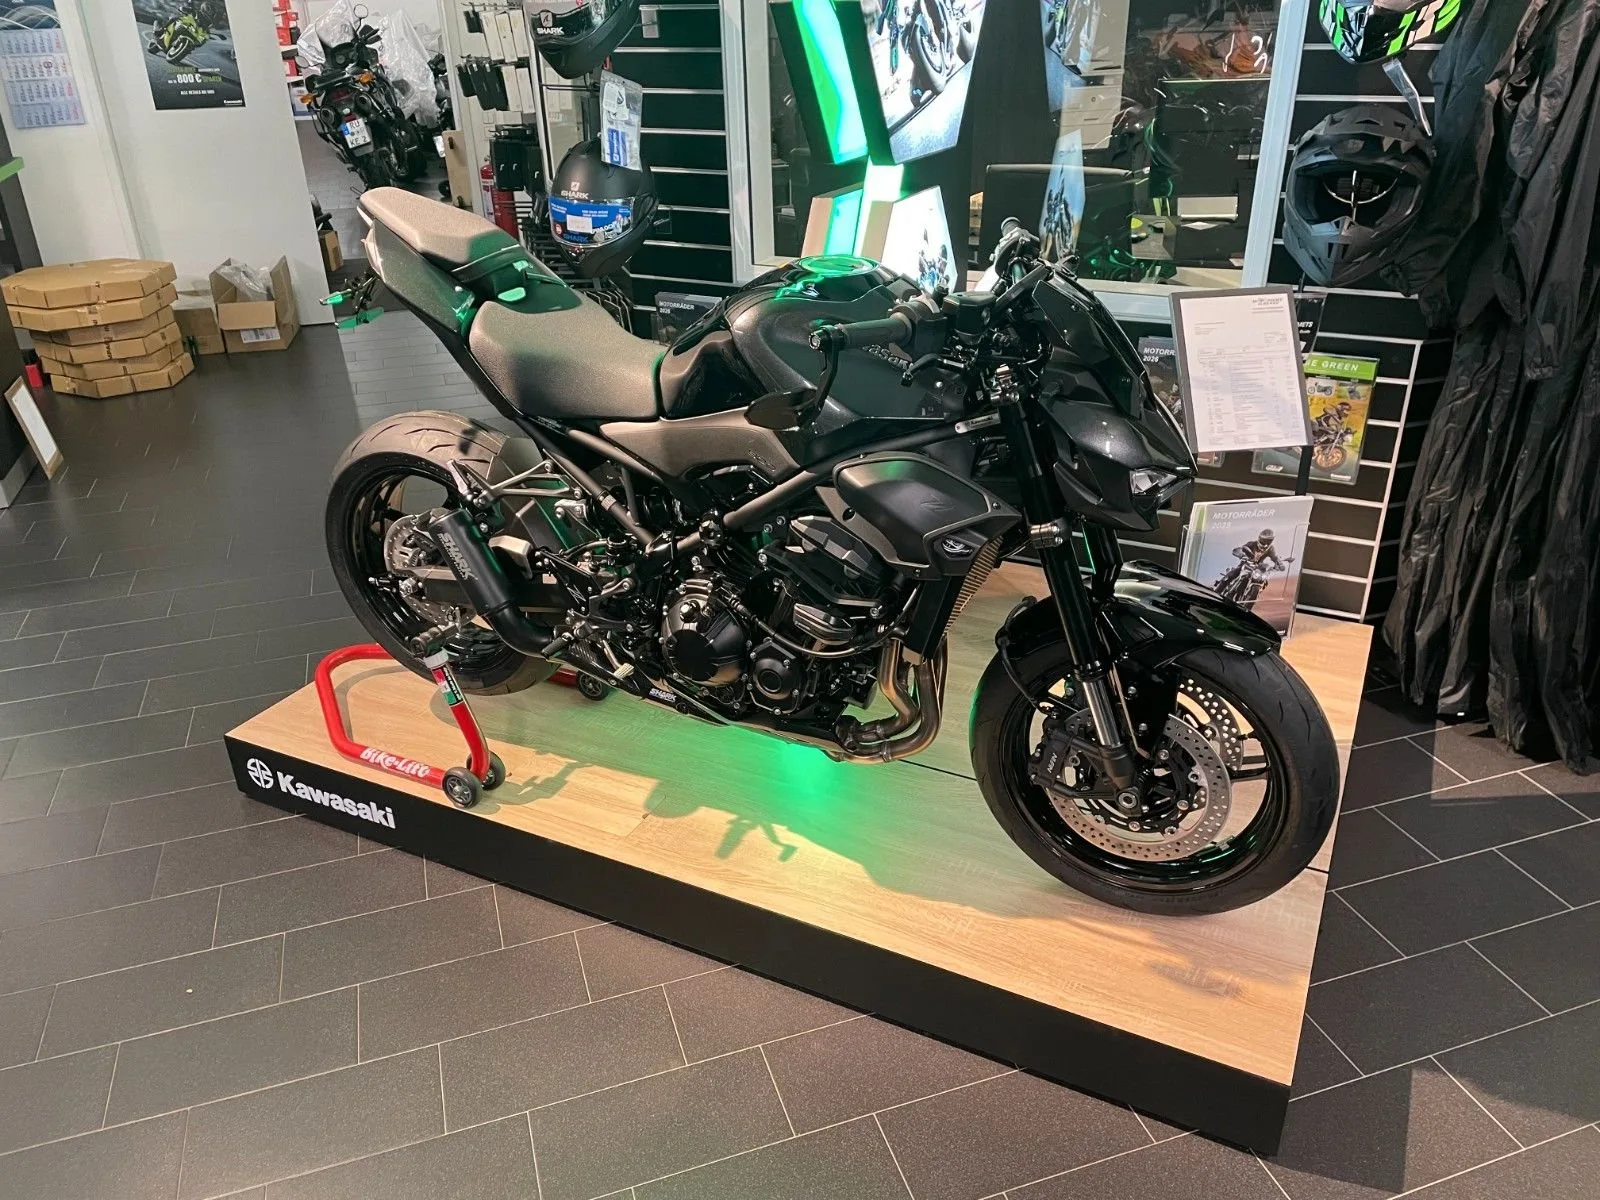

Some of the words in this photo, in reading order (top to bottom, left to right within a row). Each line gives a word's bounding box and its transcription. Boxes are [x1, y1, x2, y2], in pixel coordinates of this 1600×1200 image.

[537, 26, 565, 36] SHARK
[561, 190, 589, 199] SHARK
[659, 300, 695, 310] MOTORRÄDER
[1143, 347, 1176, 356] MOTORR
[1321, 360, 1360, 371] GREEN
[1212, 508, 1276, 520] MOTORRÄDER
[443, 532, 479, 580] SHARK
[649, 688, 677, 702] SHARK
[360, 747, 430, 778] Bike-Lift
[277, 771, 396, 830] Kawasaki
